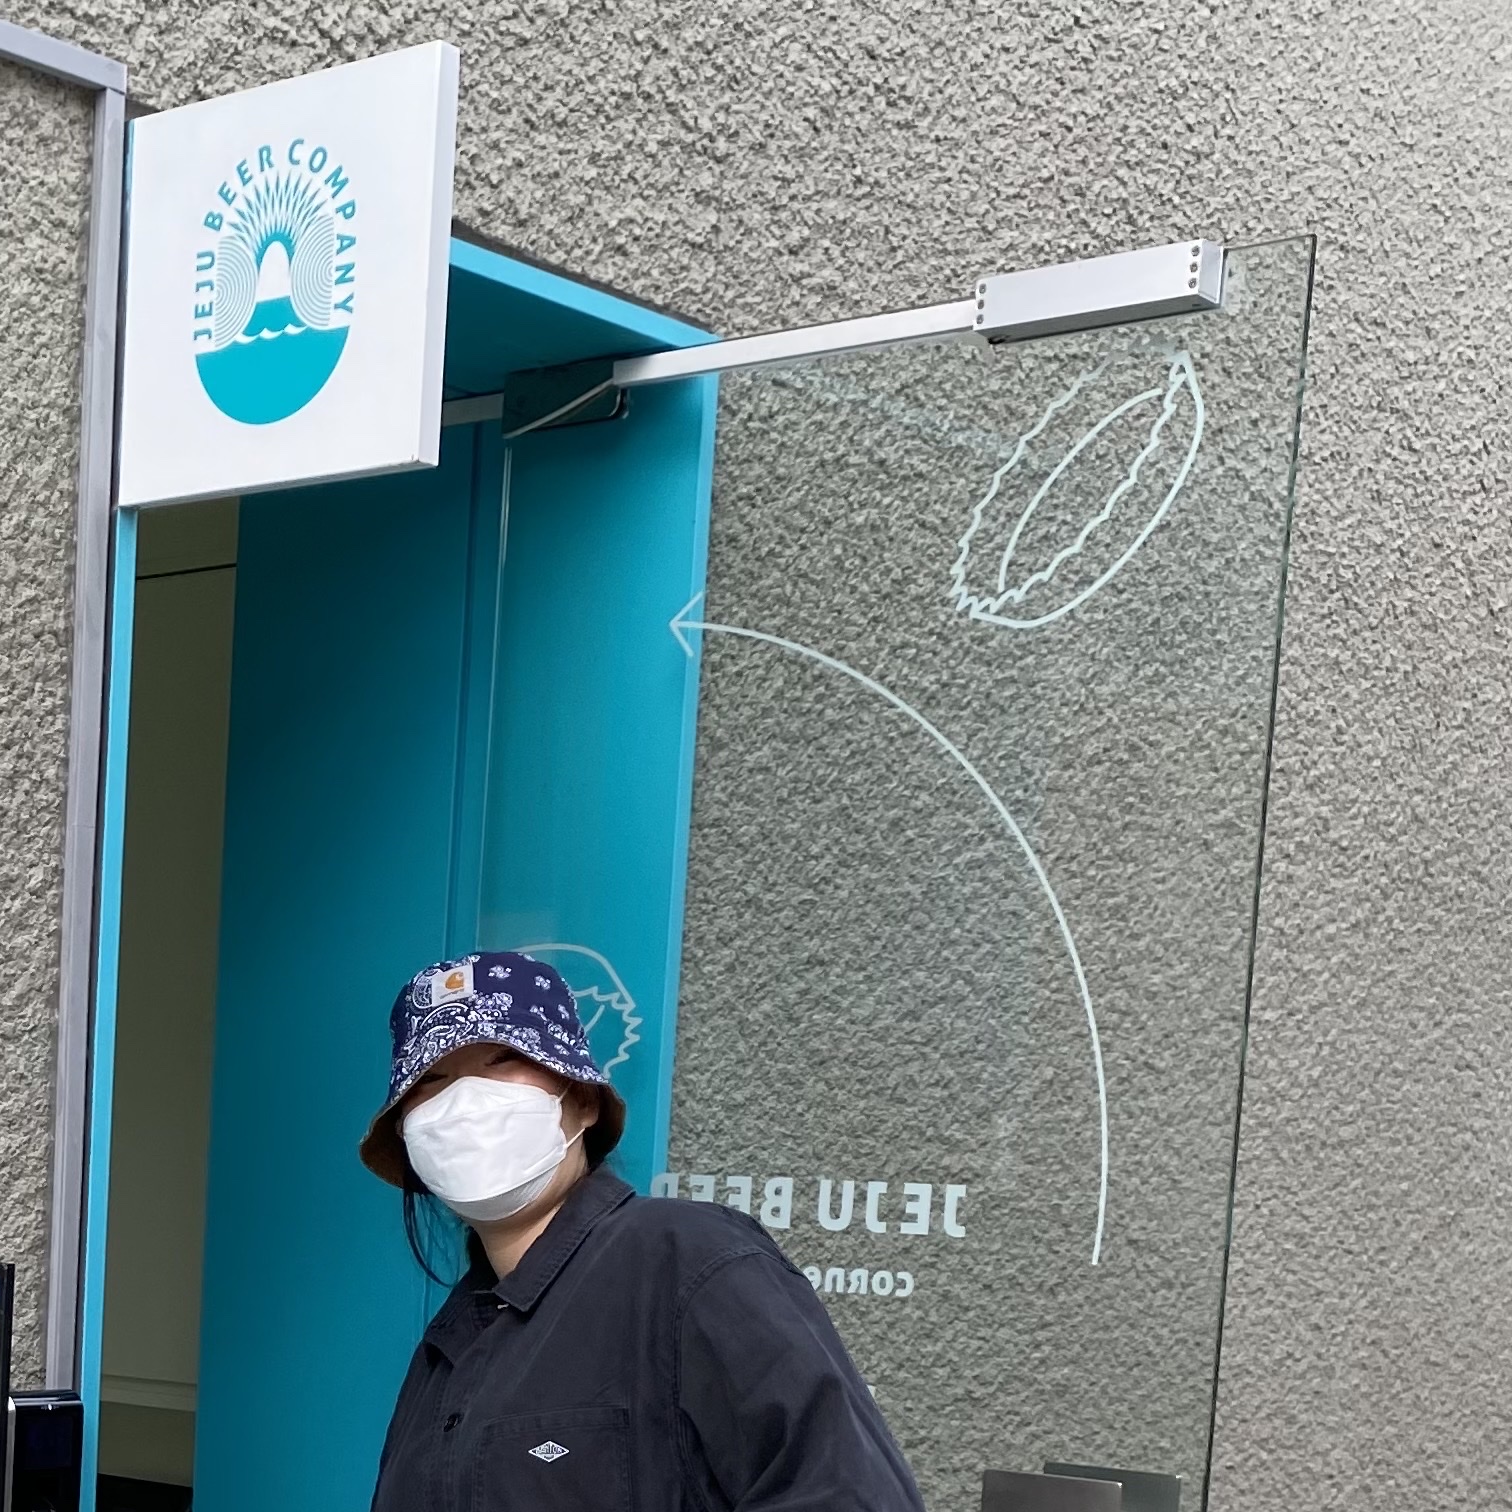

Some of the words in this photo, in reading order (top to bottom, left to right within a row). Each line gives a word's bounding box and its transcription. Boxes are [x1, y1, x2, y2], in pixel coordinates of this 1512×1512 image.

[203, 145, 274, 231] BEER
[287, 137, 357, 314] COMPANY
[193, 250, 216, 342] JEJU
